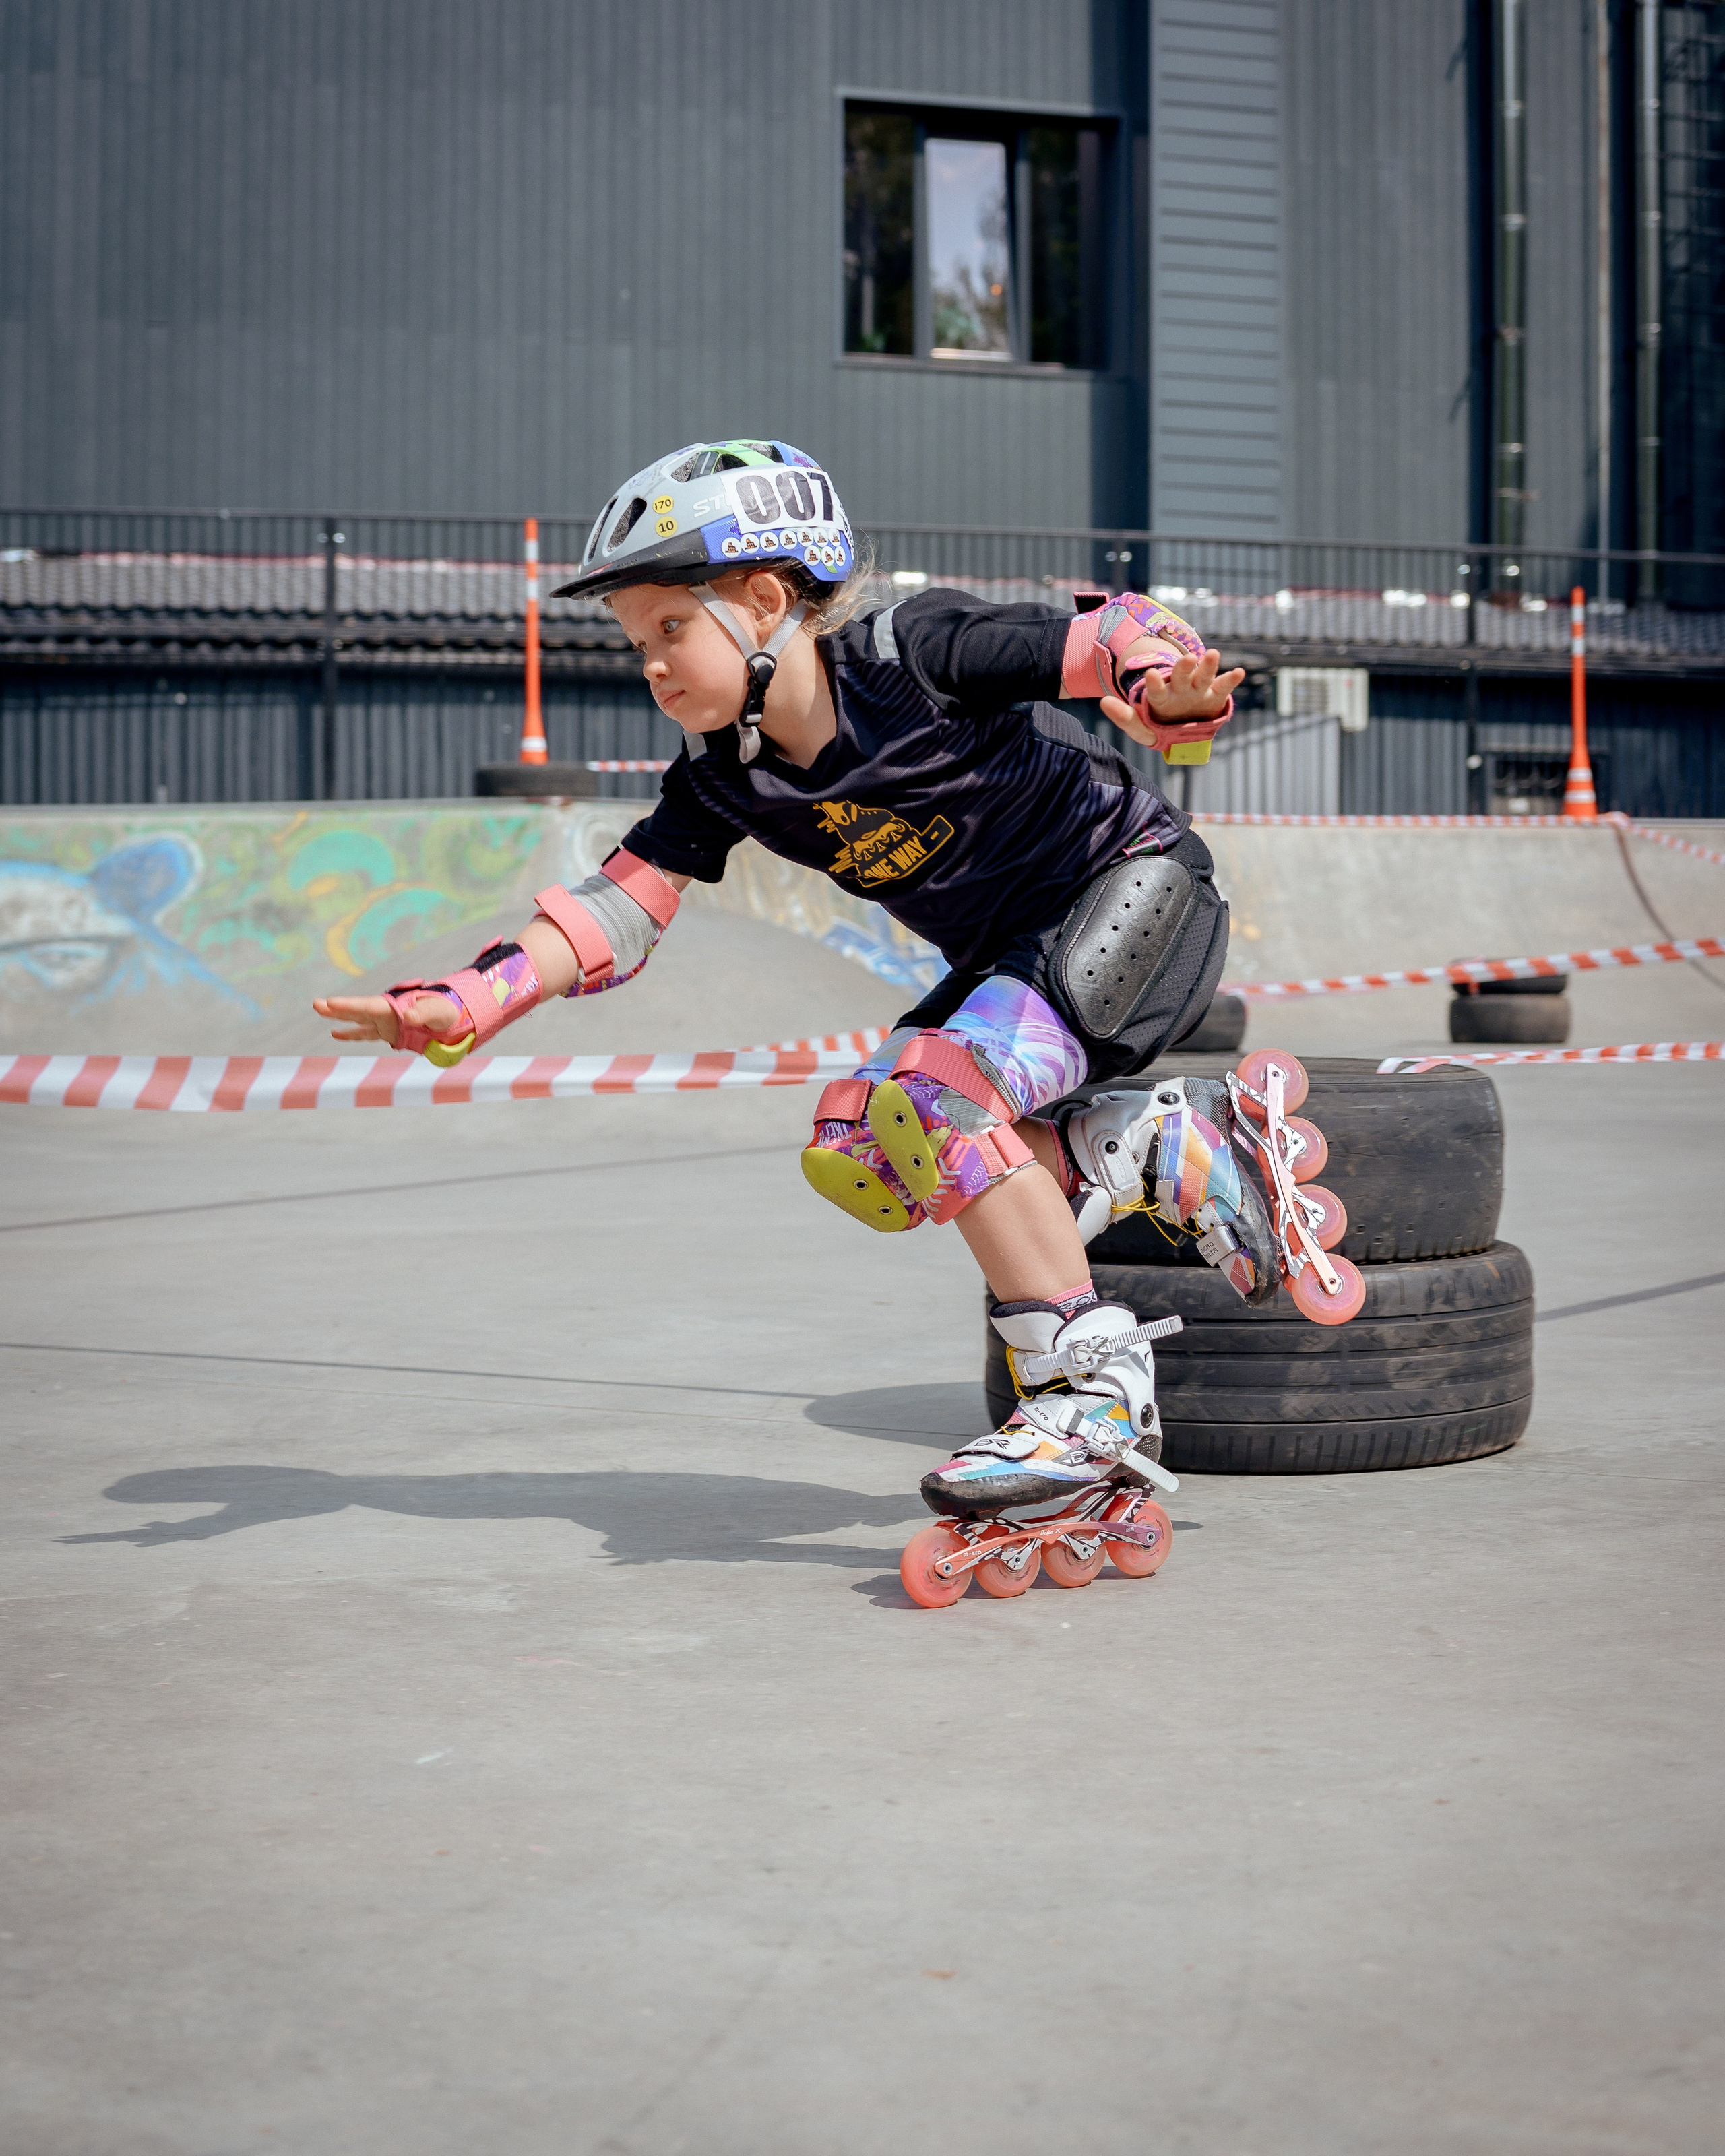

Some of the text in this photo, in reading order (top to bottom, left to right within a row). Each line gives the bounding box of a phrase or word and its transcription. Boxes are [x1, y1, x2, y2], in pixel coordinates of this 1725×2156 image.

[736, 471, 834, 524] 007
[659, 520, 675, 533] 10
[863, 836, 928, 879] ONE WAY
